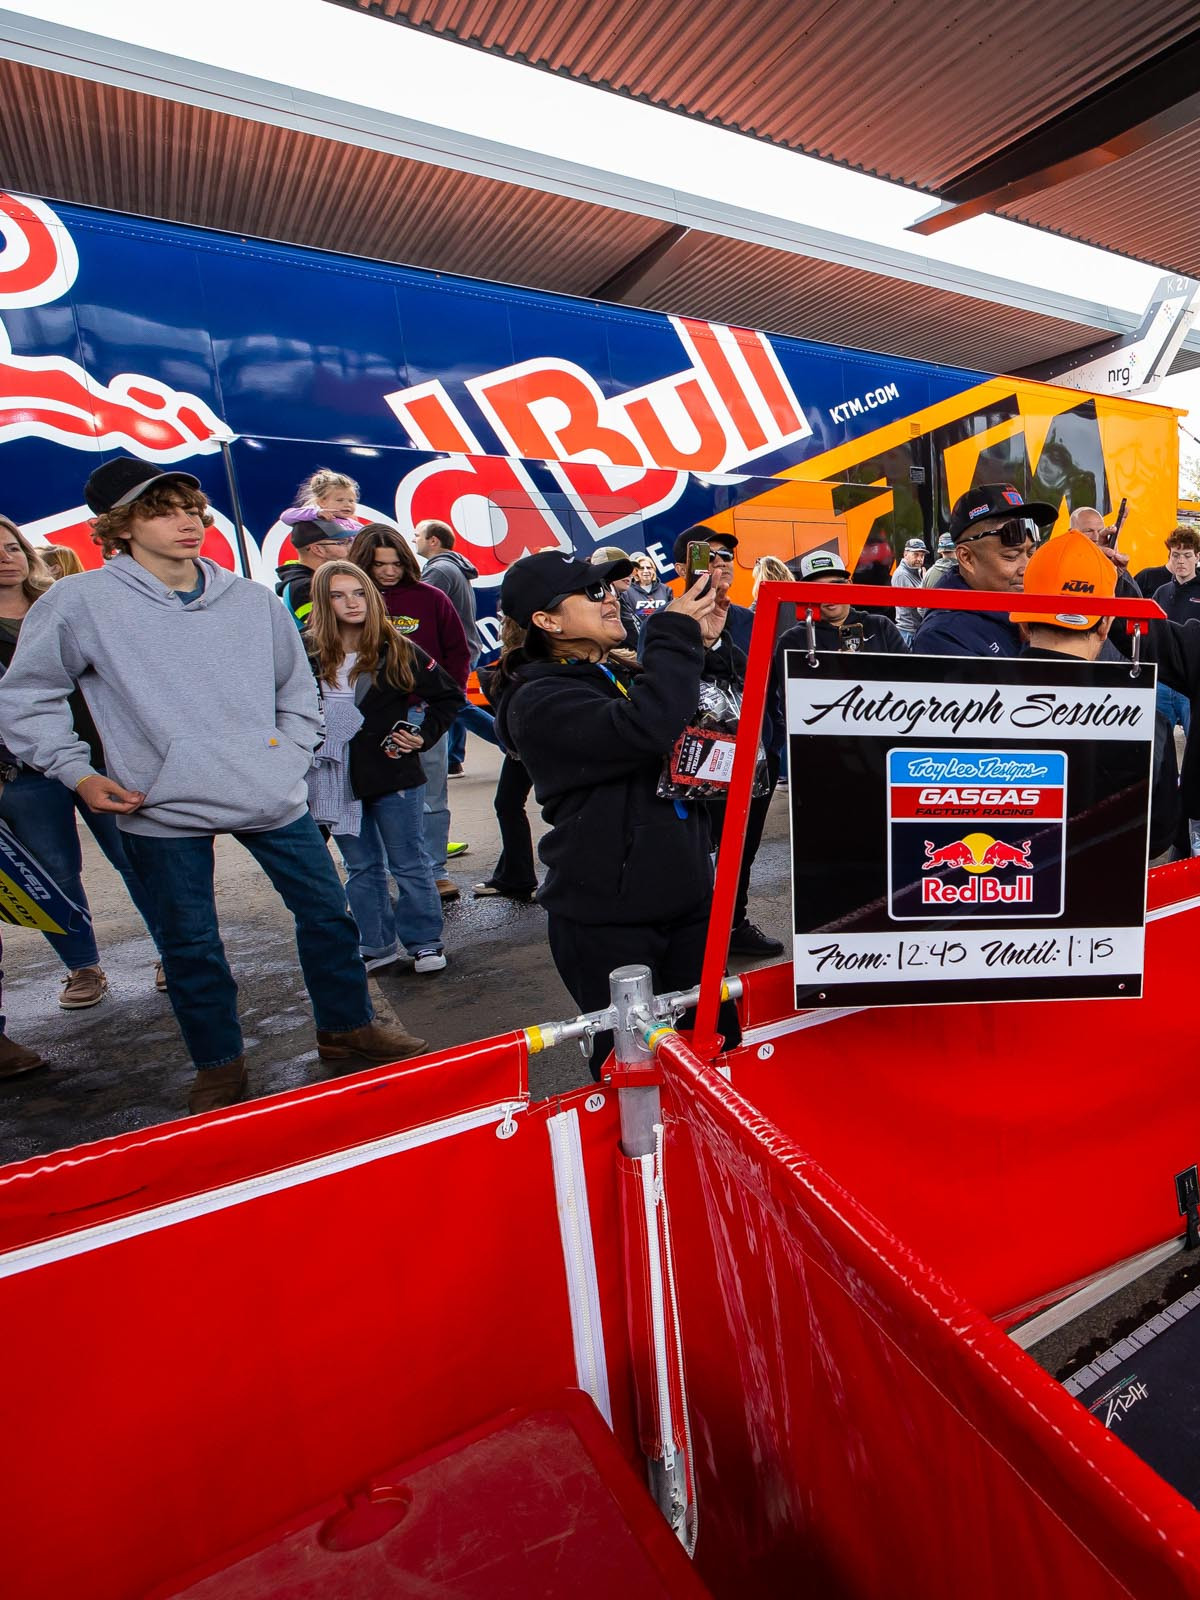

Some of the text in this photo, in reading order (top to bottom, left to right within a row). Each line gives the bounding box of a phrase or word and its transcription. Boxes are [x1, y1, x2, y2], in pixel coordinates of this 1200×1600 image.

[1108, 367, 1130, 386] nrg
[828, 382, 900, 425] KTM.COM
[465, 313, 812, 540] Bull
[1061, 579, 1095, 595] KTM
[801, 684, 1143, 735] Autograph Session
[908, 757, 1047, 782] Troy Lee Designs
[918, 788, 1040, 806] GASGAS
[915, 807, 1035, 817] FACTORY RACING
[0, 837, 51, 900] ALKEN
[0, 880, 38, 926] NLOP
[808, 943, 891, 973] From:
[981, 939, 1061, 967] Until:
[1067, 935, 1114, 967] 1:15
[759, 1044, 772, 1057] N
[588, 1096, 602, 1109] M
